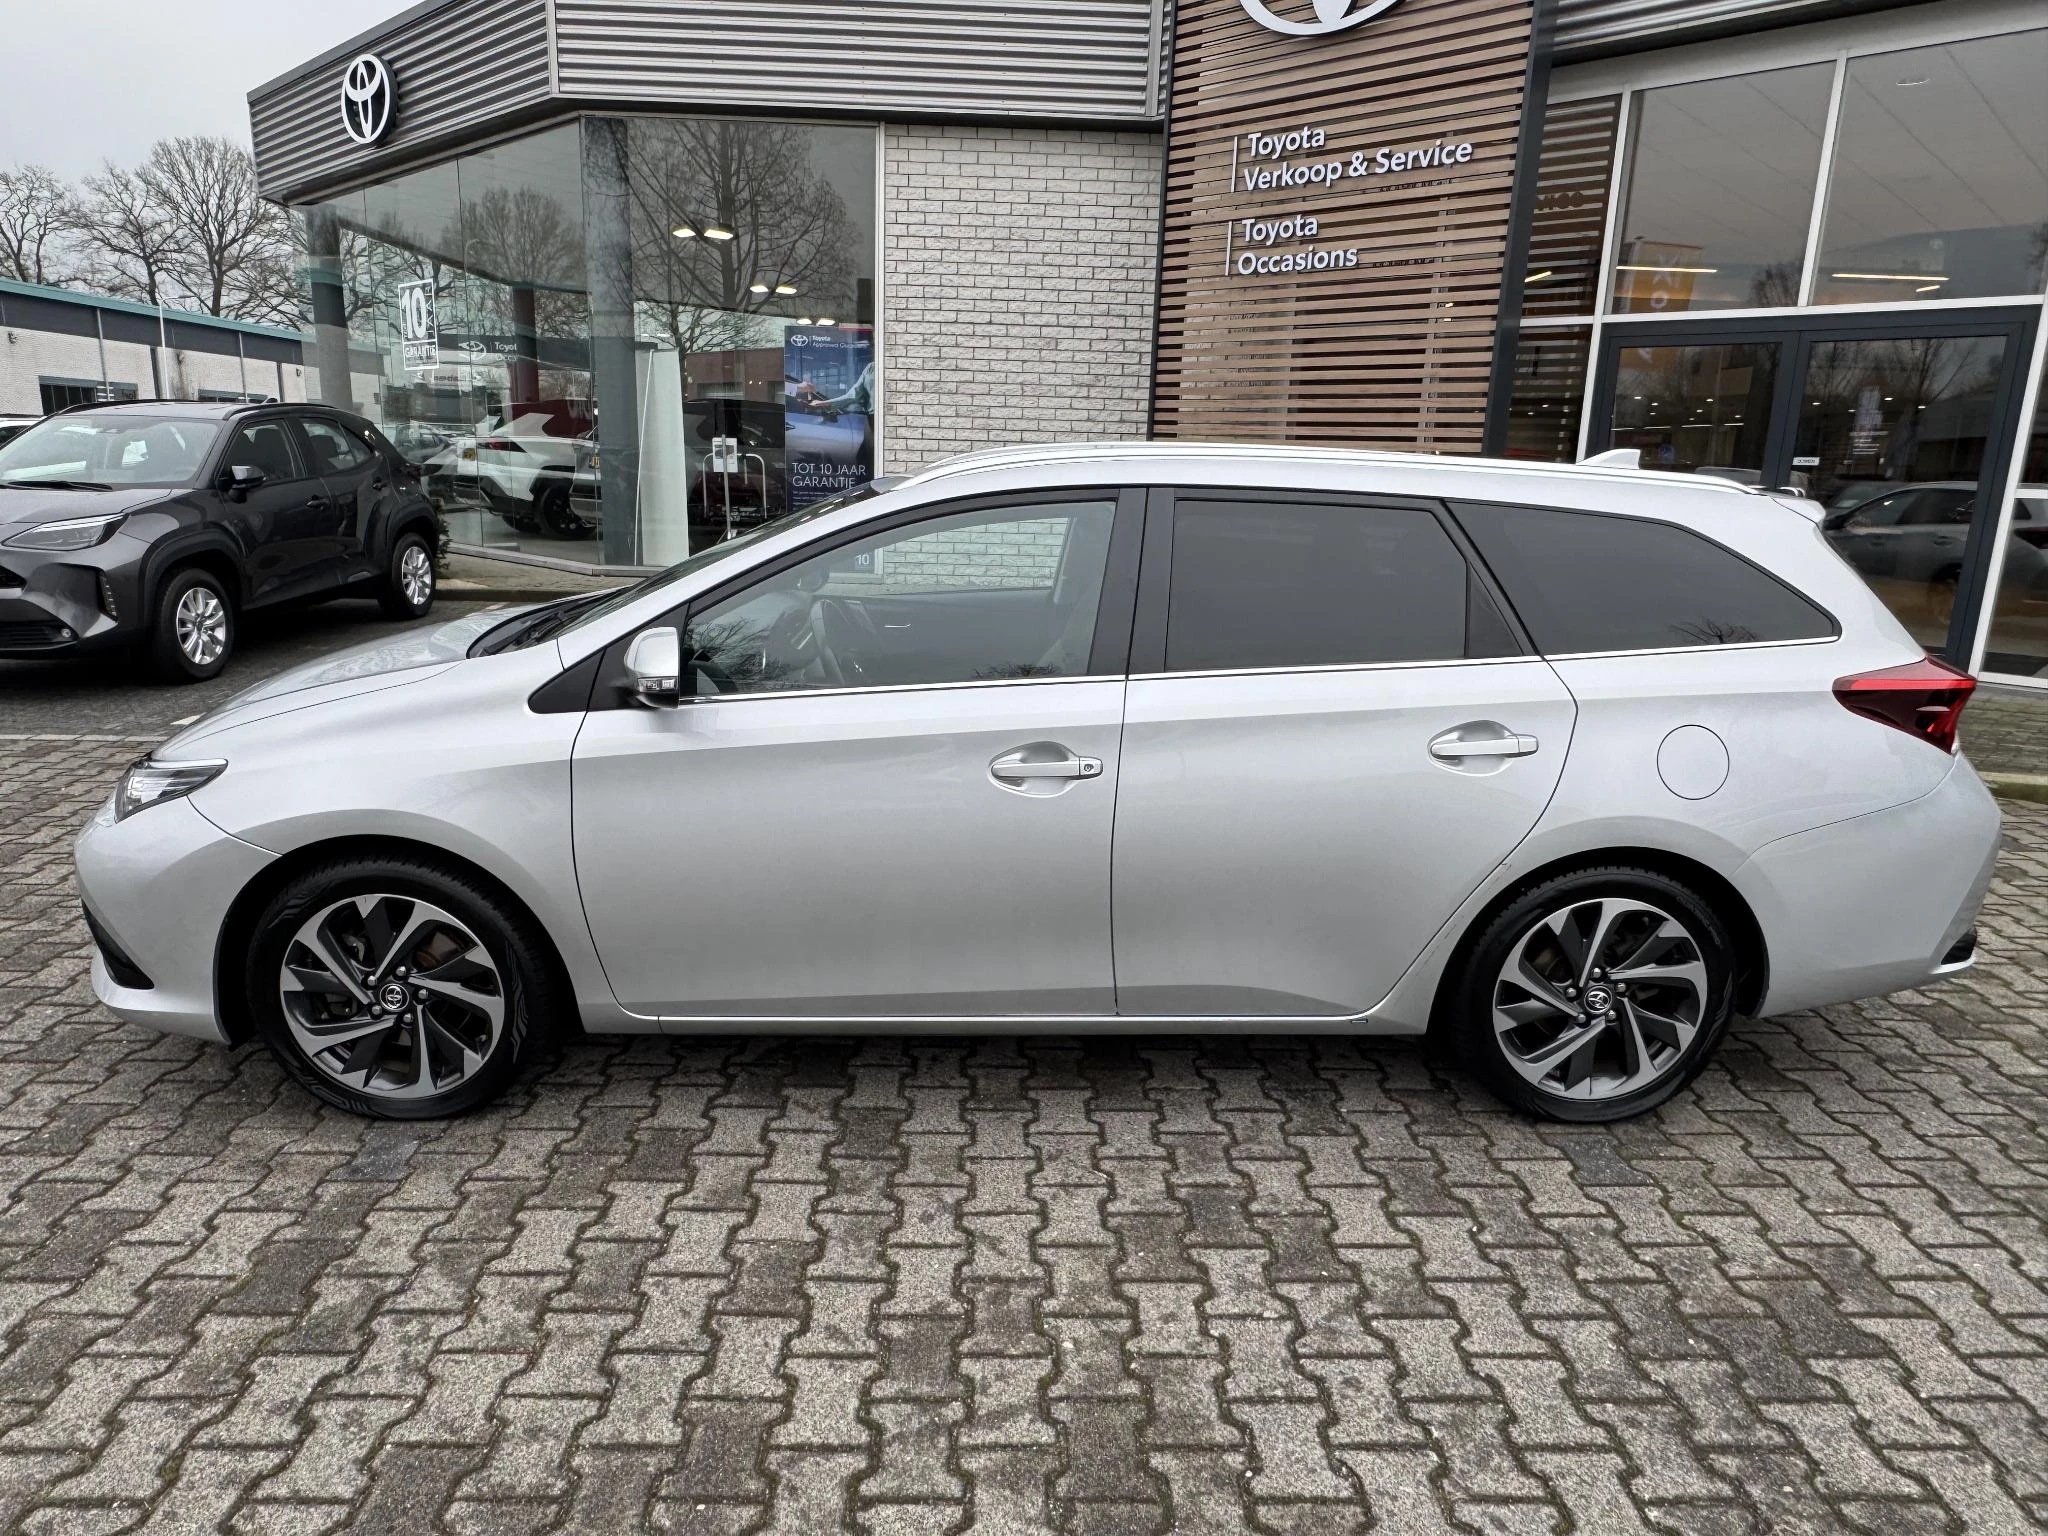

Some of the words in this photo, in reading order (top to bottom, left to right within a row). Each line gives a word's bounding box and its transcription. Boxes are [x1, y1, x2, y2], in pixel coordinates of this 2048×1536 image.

[1248, 126, 1326, 160] Toyota
[1244, 161, 1343, 191] Verkoop
[1348, 151, 1368, 177] &
[1375, 139, 1473, 174] Service
[1241, 214, 1319, 245] Toyota
[1237, 245, 1359, 275] Occasions
[401, 287, 427, 339] 10
[791, 462, 816, 474] TOT
[820, 463, 833, 475] 10
[835, 464, 866, 476] JAAR
[855, 554, 870, 565] 10
